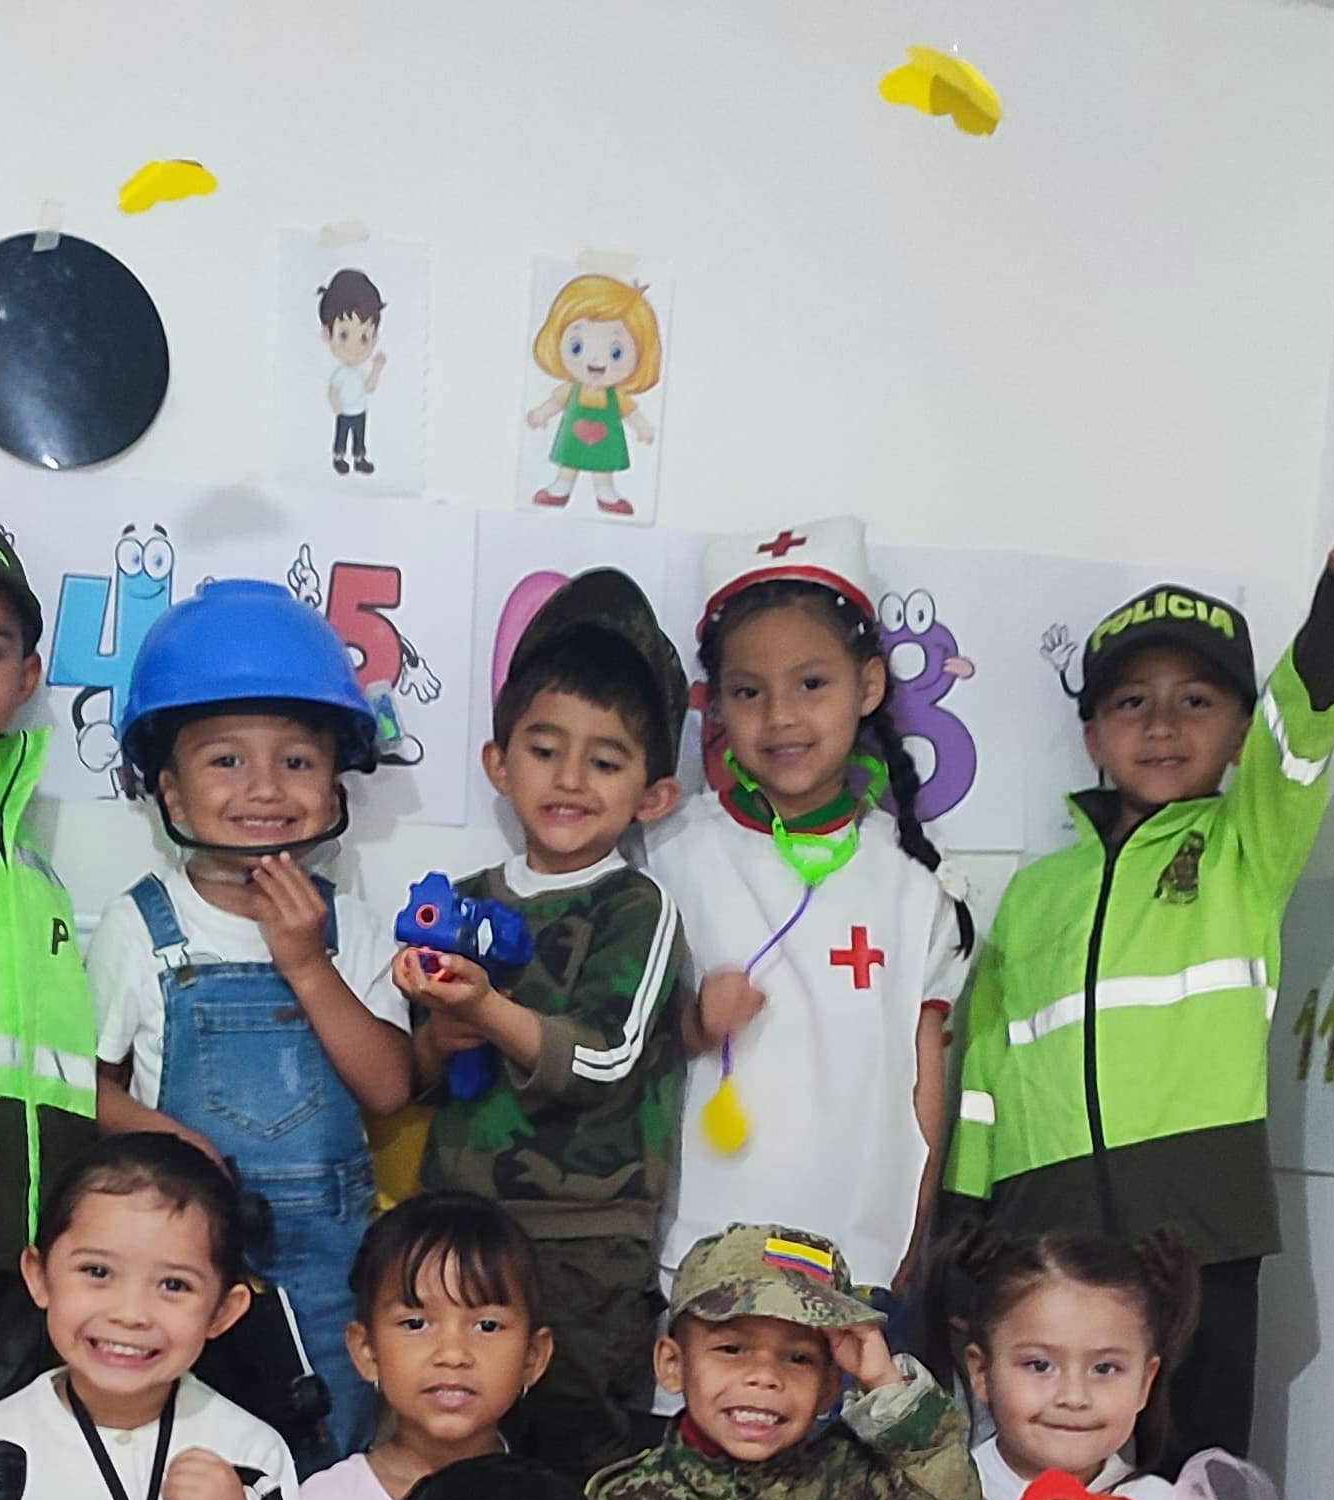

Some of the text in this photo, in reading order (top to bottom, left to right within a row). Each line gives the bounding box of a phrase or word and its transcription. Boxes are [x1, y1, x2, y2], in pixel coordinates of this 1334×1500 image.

[47, 552, 172, 738] 4
[326, 561, 403, 696] 5
[1091, 590, 1236, 652] POLICIA
[847, 618, 979, 824] 8
